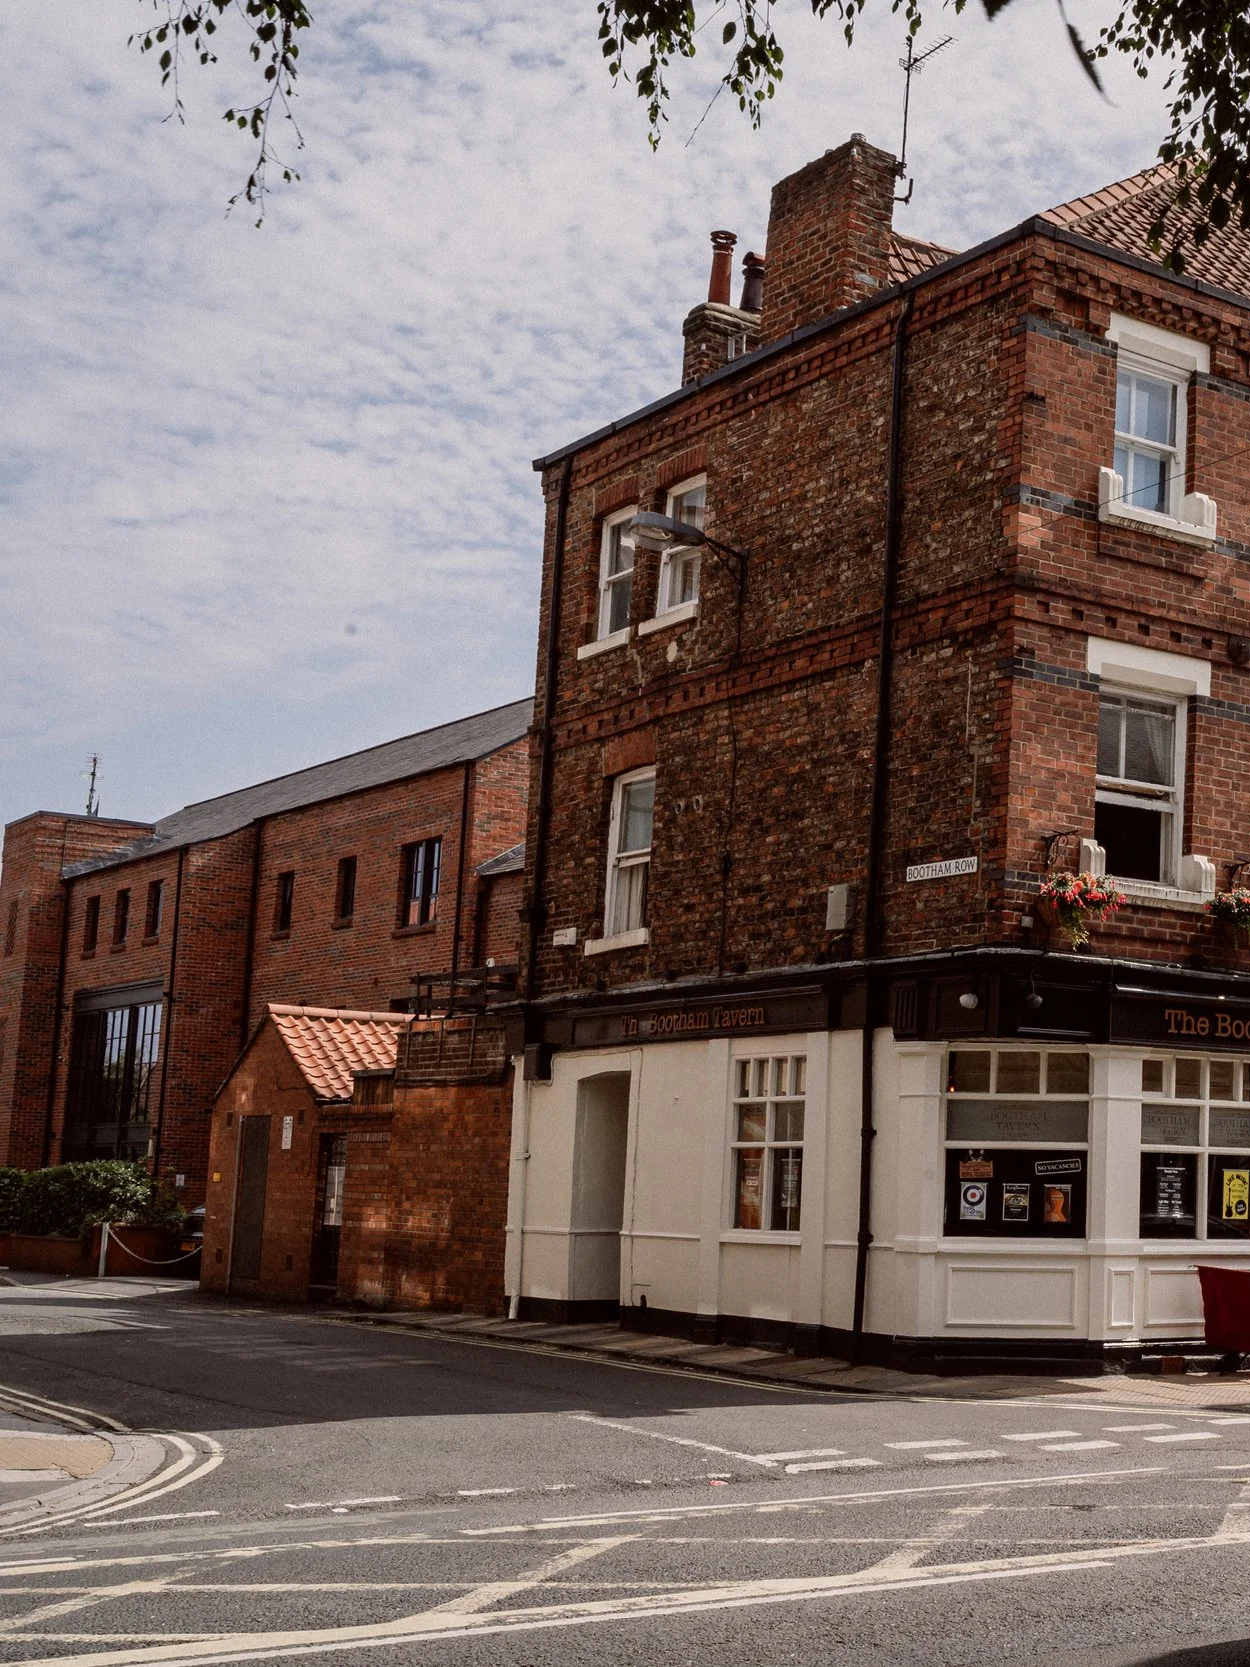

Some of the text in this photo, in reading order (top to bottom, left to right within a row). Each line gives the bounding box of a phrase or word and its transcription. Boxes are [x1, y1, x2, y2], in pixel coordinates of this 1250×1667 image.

[908, 858, 976, 880] BOOTHAM ROW
[648, 1008, 709, 1034] Bootham
[713, 1005, 765, 1028] Tavern
[1165, 1008, 1210, 1035] The
[1047, 1162, 1080, 1171] VACANCIES
